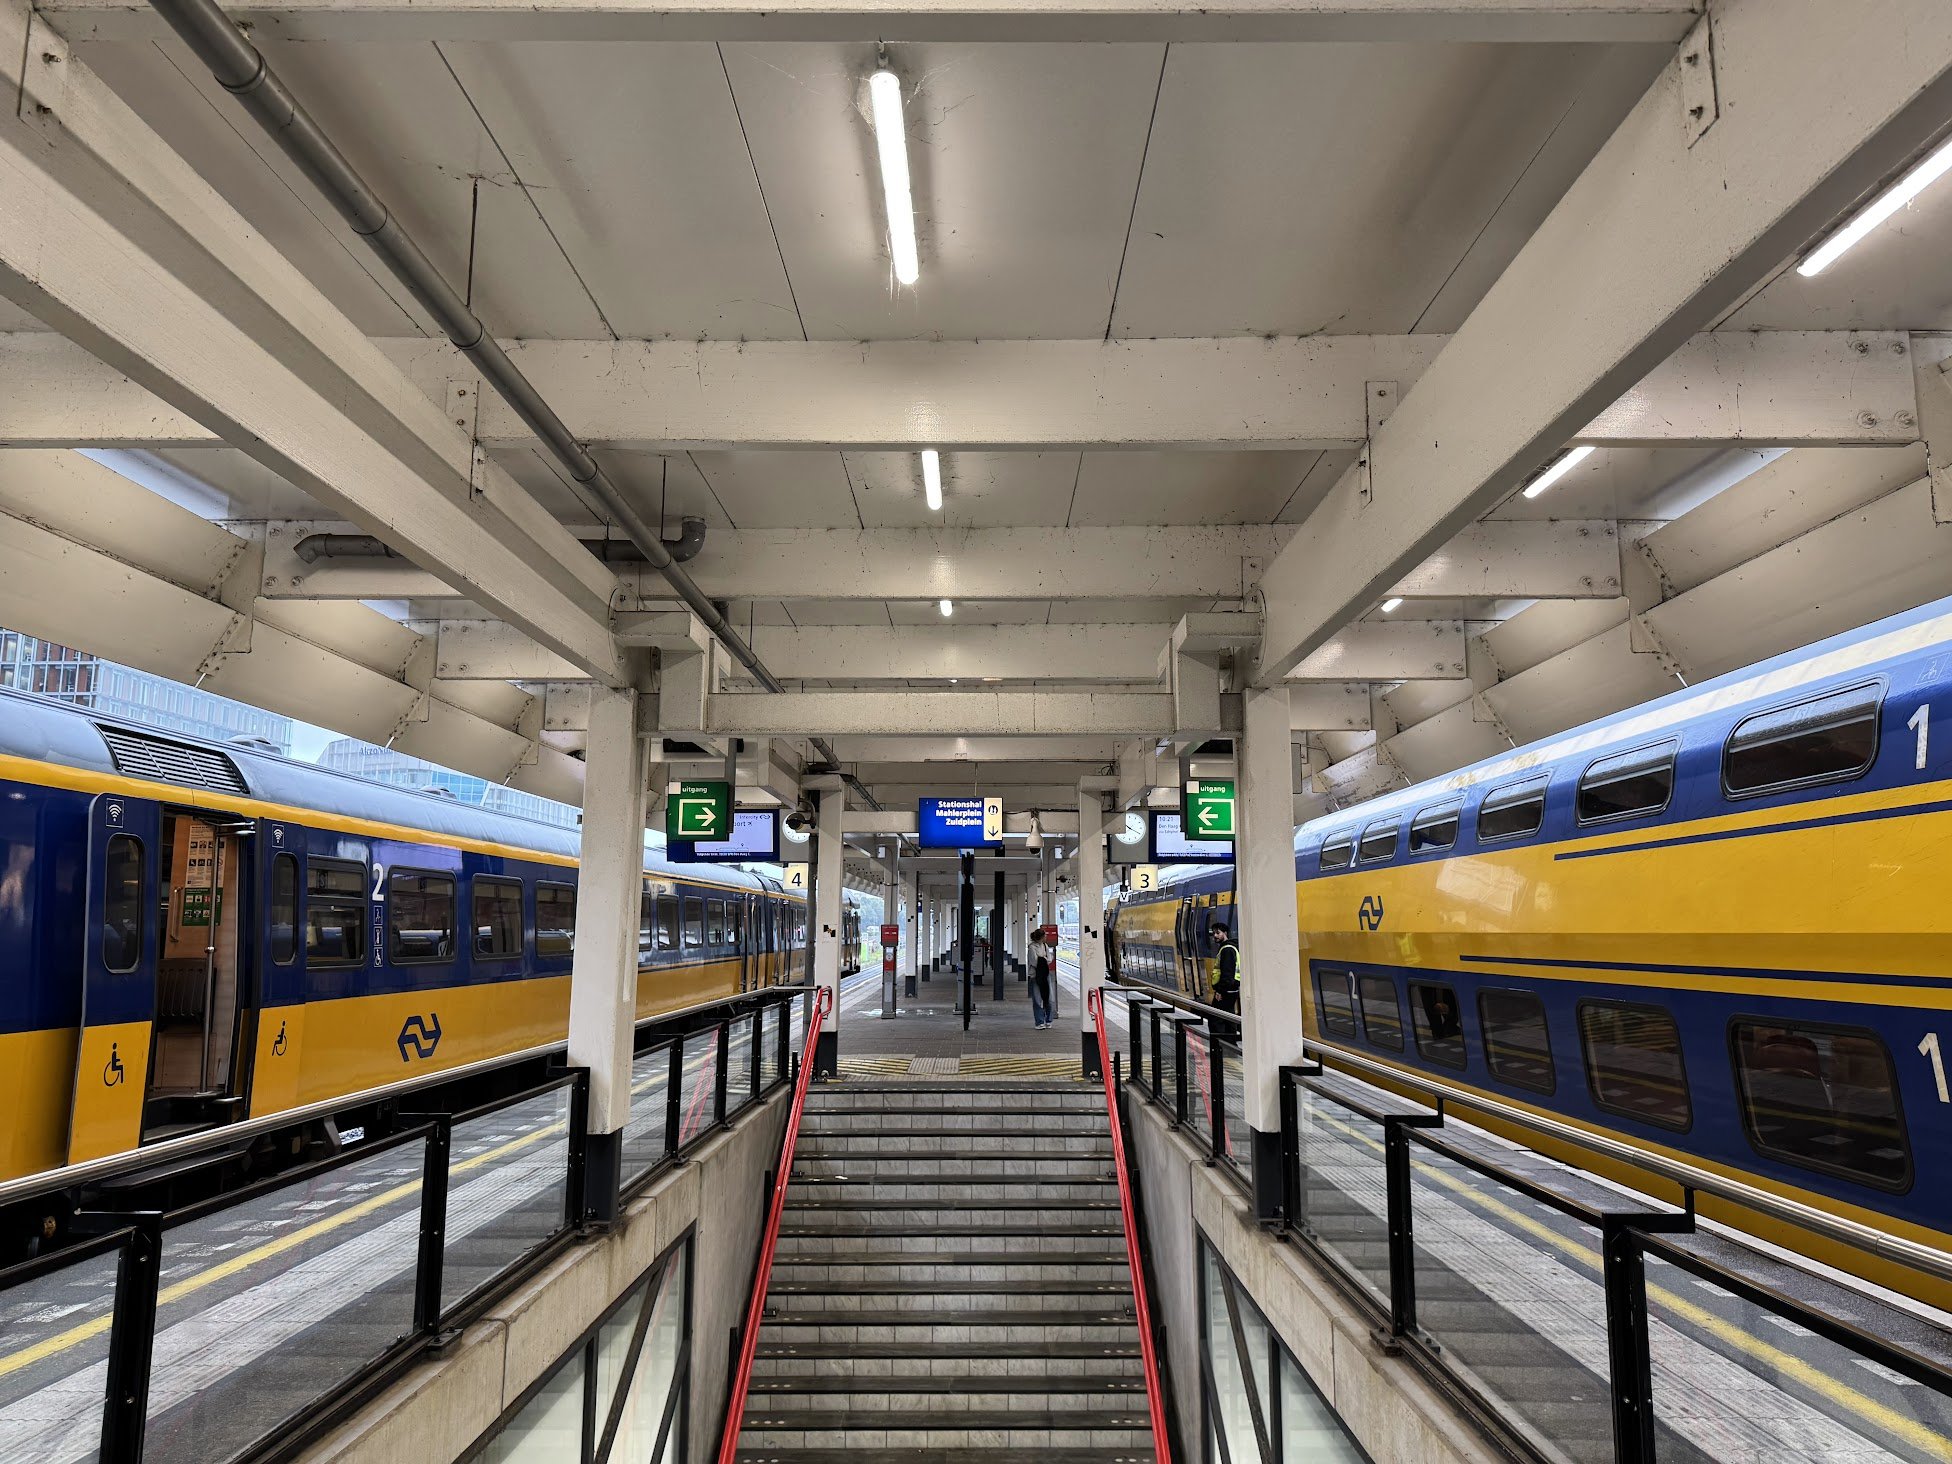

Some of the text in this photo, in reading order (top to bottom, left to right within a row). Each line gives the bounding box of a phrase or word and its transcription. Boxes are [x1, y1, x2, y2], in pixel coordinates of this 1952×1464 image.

[1906, 703, 1930, 770] 1
[682, 785, 708, 794] uitgang
[1200, 785, 1226, 794] uitgang
[938, 800, 982, 808] Stationshal
[935, 809, 982, 818] Mahlerplein
[945, 818, 982, 827] Zuidplein
[1350, 840, 1358, 868] 2
[372, 862, 385, 902] 2
[791, 872, 802, 887] 4
[1140, 873, 1150, 889] 3
[1349, 970, 1358, 1000] 2
[1917, 1032, 1951, 1104] 1
